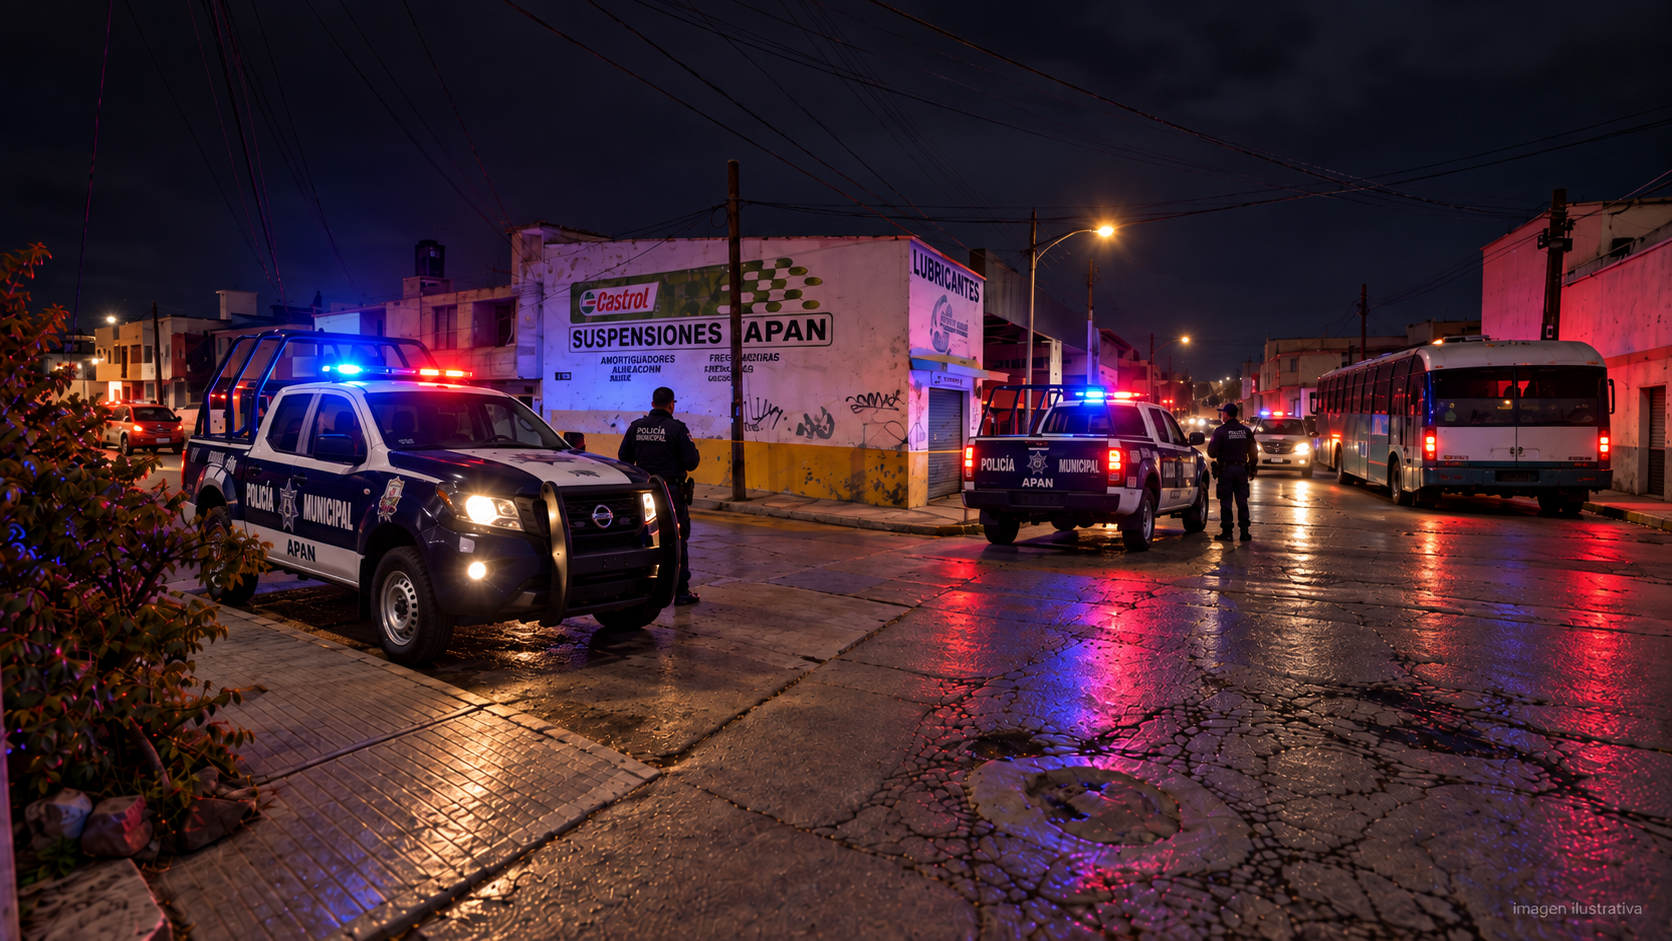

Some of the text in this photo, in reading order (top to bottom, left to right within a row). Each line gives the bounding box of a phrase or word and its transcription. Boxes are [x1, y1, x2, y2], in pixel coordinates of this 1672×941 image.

[913, 249, 980, 303] LUBRICANTES
[597, 287, 649, 312] Castrol
[572, 318, 826, 348] SUSPENSIONES APAN
[637, 426, 666, 435] POLICÍA
[981, 455, 1100, 474] POLICÍA MUNICIPAL
[1022, 478, 1054, 488] APAN
[246, 480, 353, 531] POLICÍA MUNICIPAL
[287, 539, 316, 563] APAN
